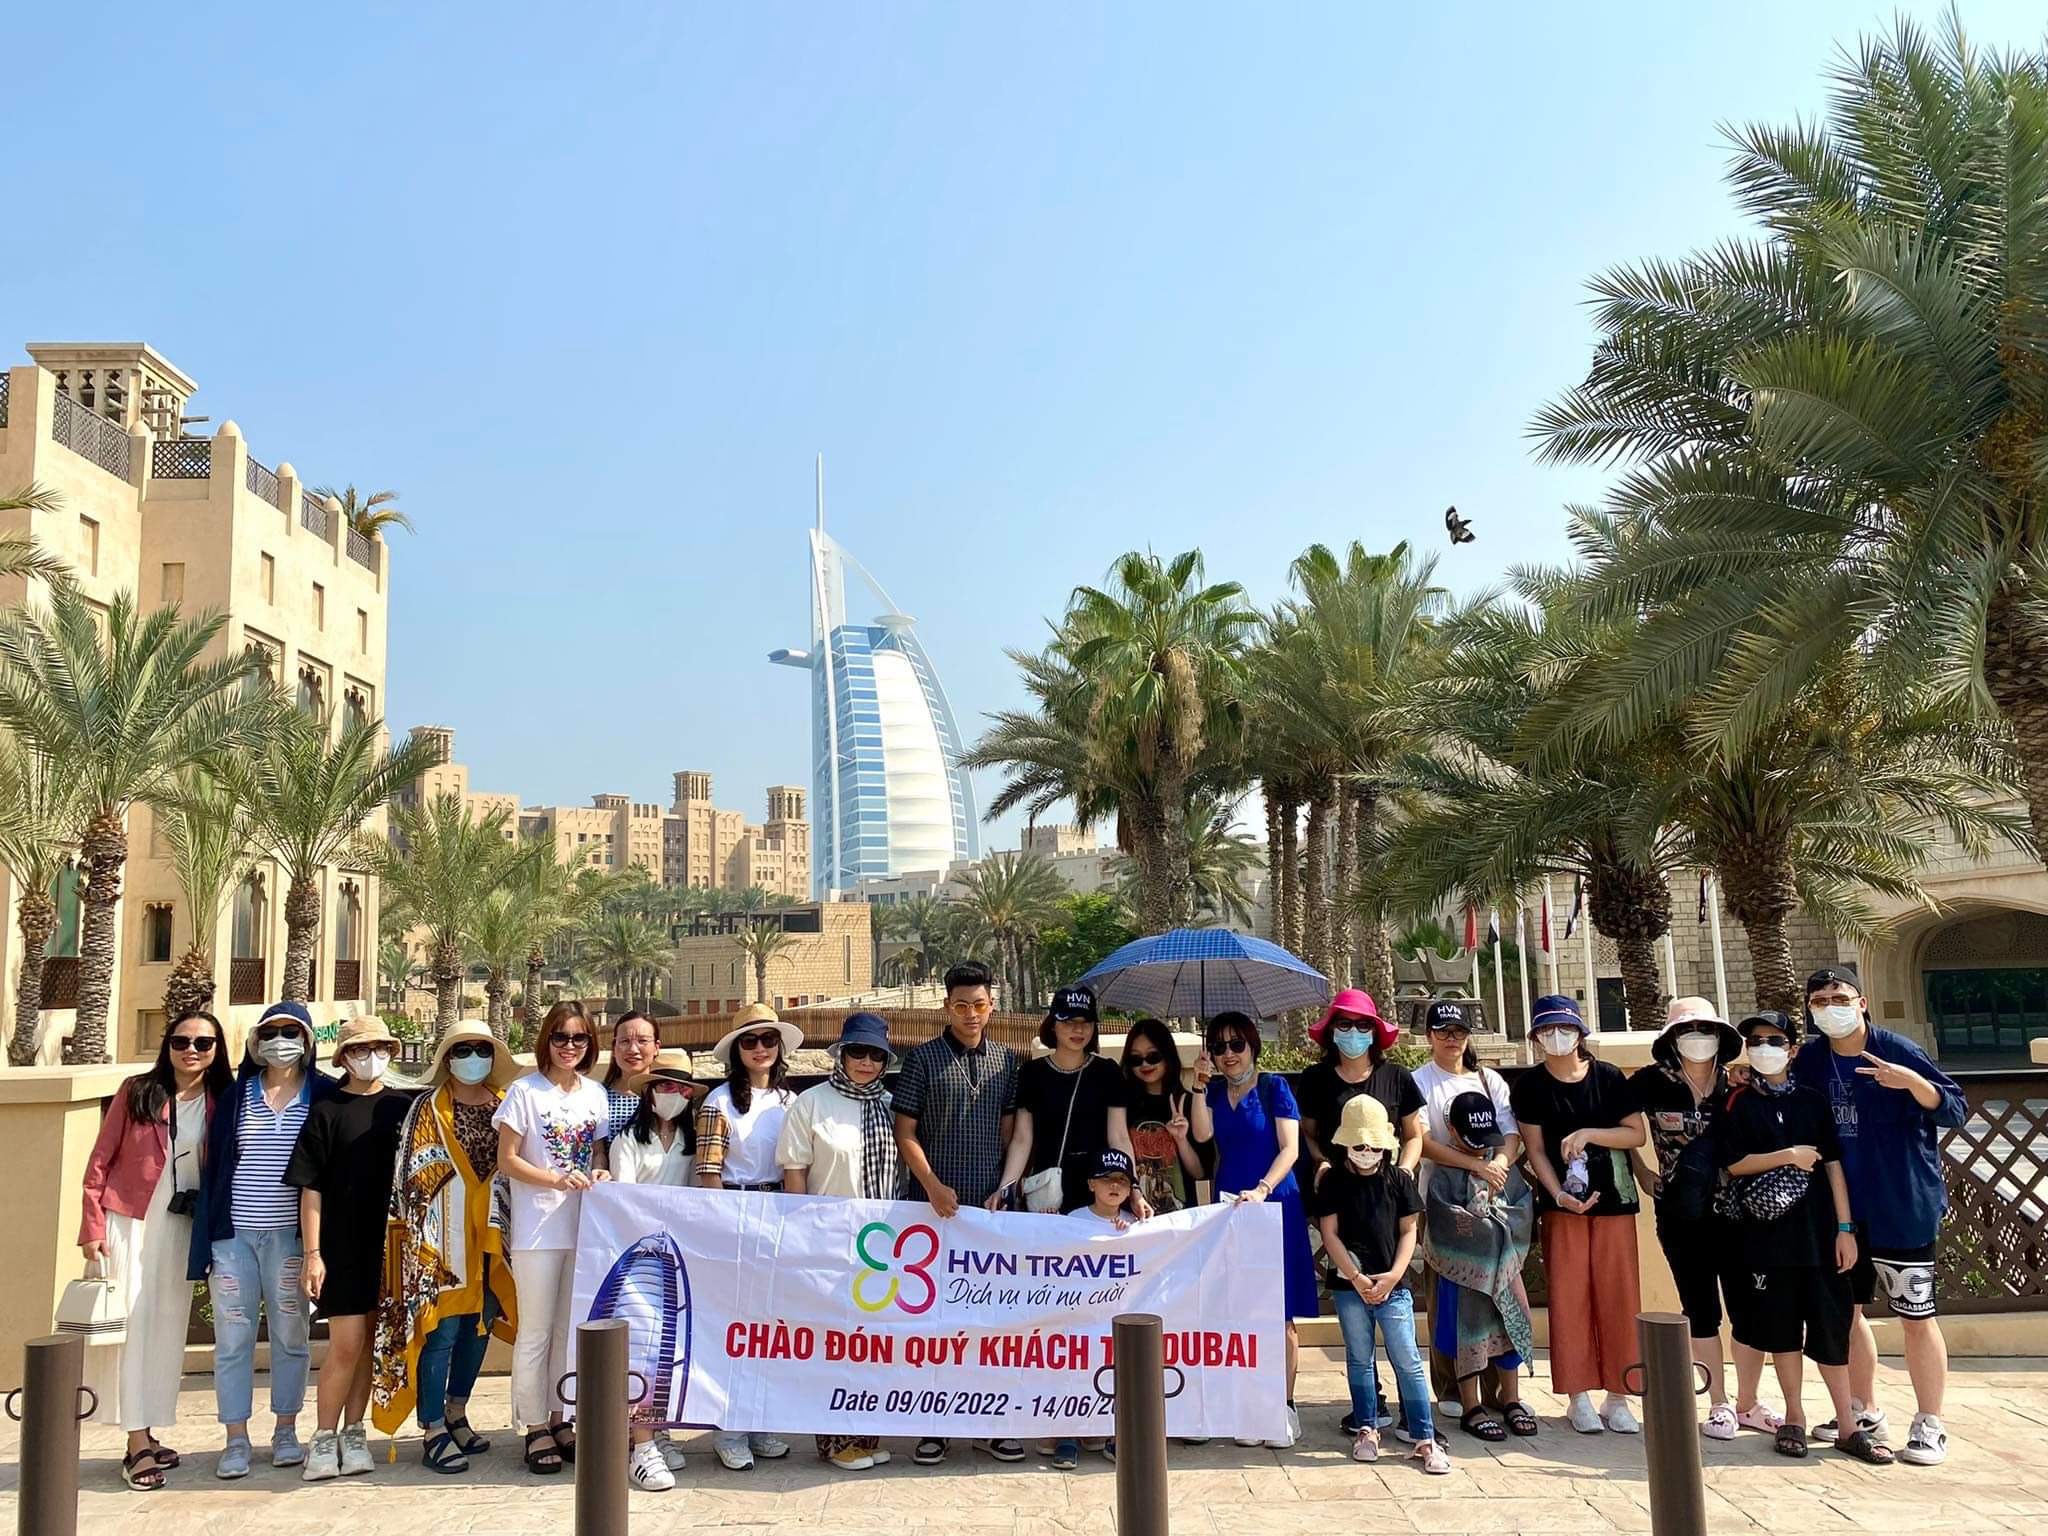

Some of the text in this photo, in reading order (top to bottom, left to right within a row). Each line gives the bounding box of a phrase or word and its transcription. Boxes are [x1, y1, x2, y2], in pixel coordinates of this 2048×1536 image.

[1066, 992, 1090, 1004] HVN
[1437, 1004, 1462, 1015] HVN
[1468, 1111, 1493, 1123] HVN
[1102, 1151, 1127, 1165] HVN
[948, 1249, 1142, 1279] HVN TRAVEL
[945, 1277, 993, 1310] Dịch
[999, 1290, 1021, 1310] vụ
[1027, 1283, 1056, 1305] với
[1056, 1290, 1082, 1311] nụ
[725, 1318, 815, 1361] CHÀO
[824, 1325, 894, 1365] ĐÓN
[904, 1330, 970, 1369] QUÝ
[978, 1328, 1090, 1371] KHÁCH
[1162, 1331, 1258, 1369] DUBAI
[829, 1387, 879, 1413] Date
[885, 1389, 1010, 1418] 09/06/2022
[1031, 1394, 1115, 1420] 14/06/2
